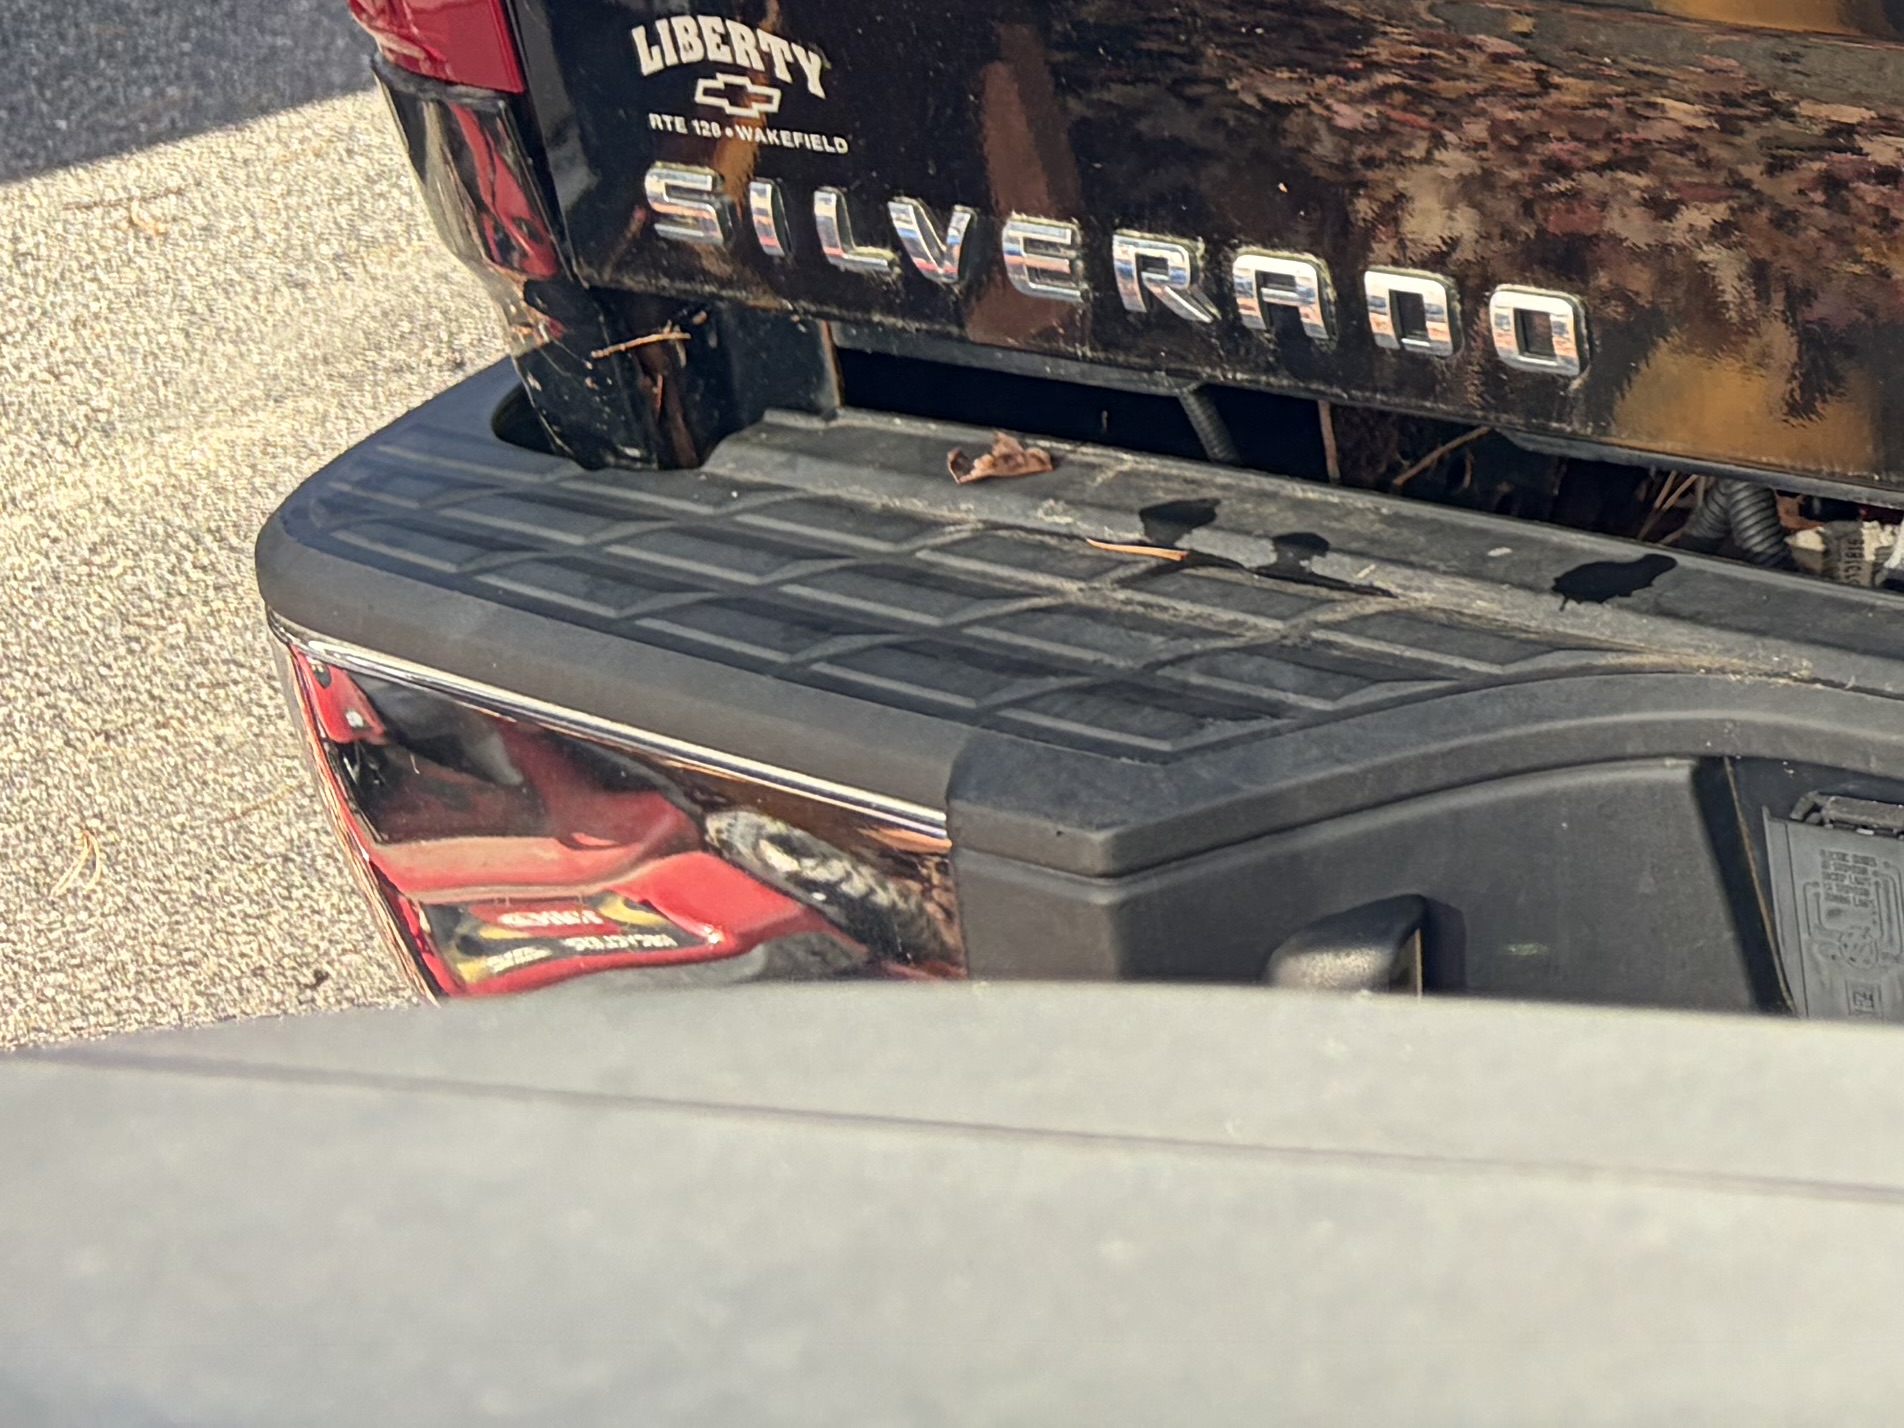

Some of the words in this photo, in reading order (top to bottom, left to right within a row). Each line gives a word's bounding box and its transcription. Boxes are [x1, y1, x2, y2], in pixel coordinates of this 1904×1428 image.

[631, 14, 826, 100] LIBERTY
[649, 112, 688, 135] RTE
[692, 118, 722, 139] 128
[734, 124, 849, 155] WAKEFIELD
[643, 160, 1597, 378] SILVERADO
